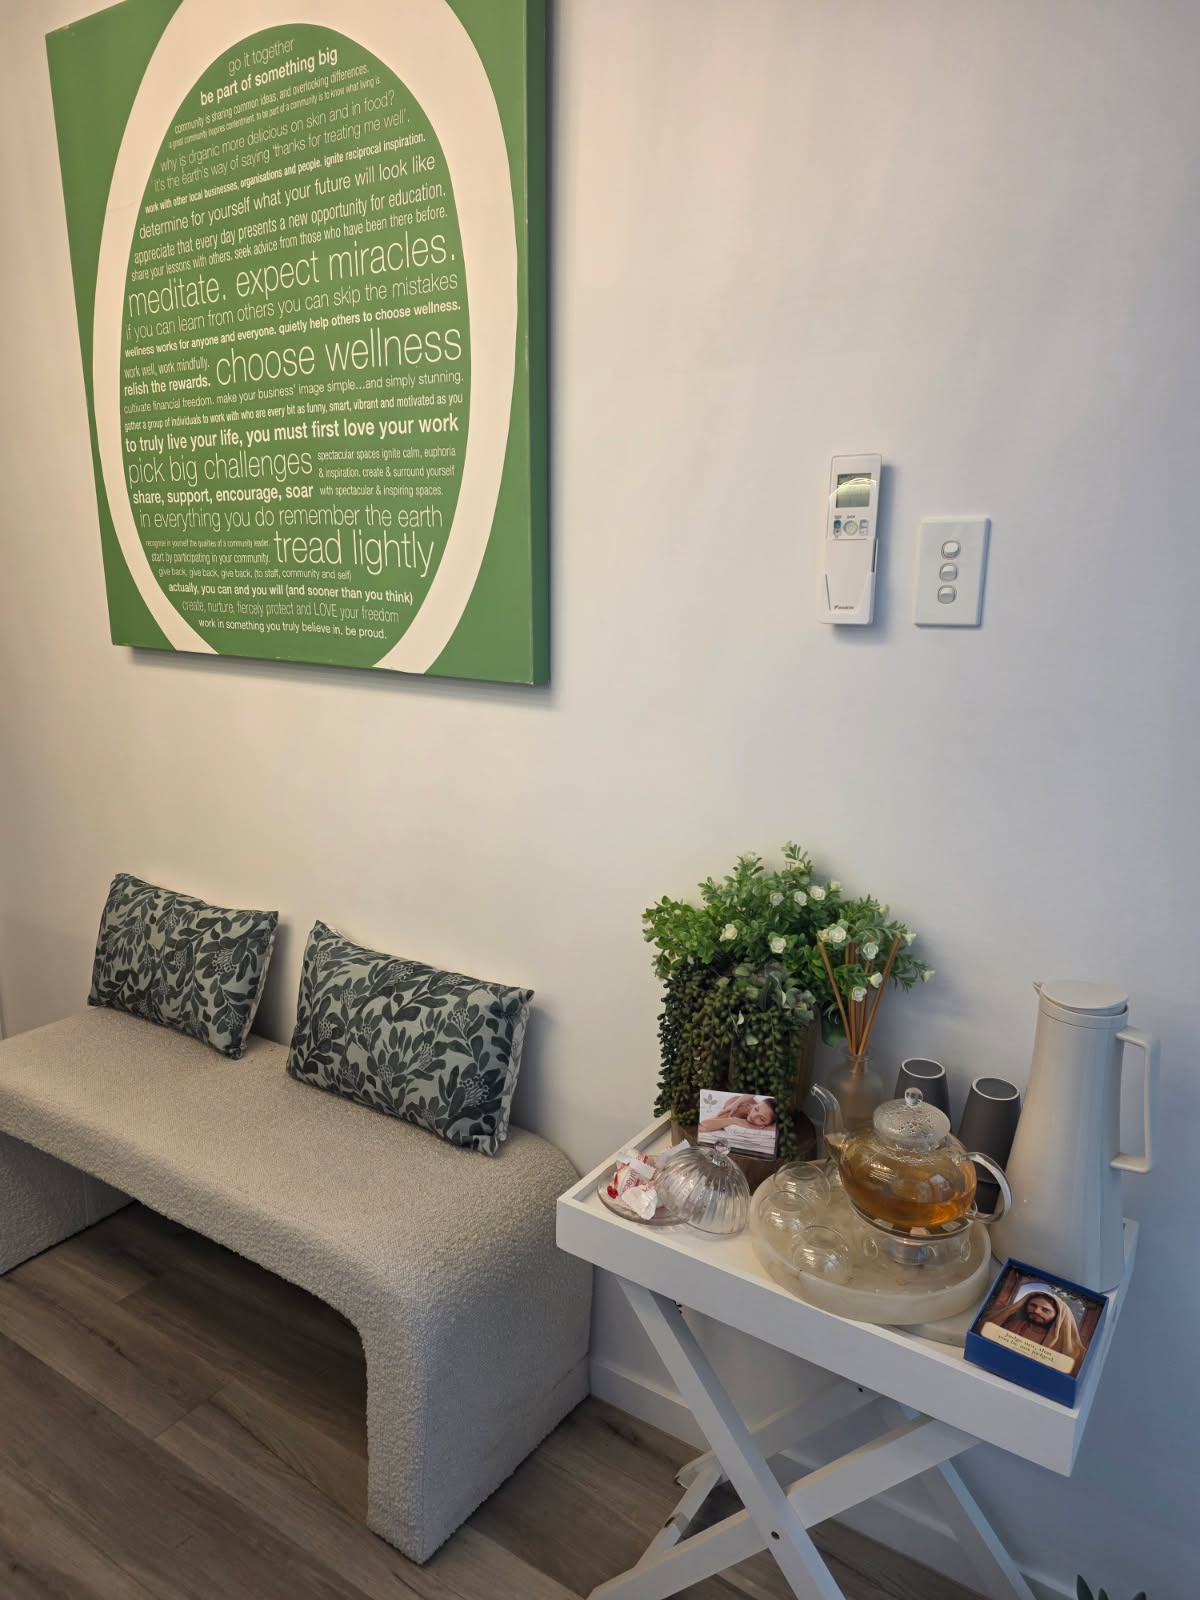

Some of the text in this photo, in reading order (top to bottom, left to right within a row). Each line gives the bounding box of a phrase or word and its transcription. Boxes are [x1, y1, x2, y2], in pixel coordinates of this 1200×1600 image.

[200, 47, 338, 106] be part of something big
[228, 39, 294, 77] go it together
[139, 154, 435, 239] determine for yourself what your future will look like
[145, 201, 159, 213] work
[159, 198, 172, 210] with
[172, 195, 188, 207] other
[188, 189, 203, 202] local
[240, 168, 283, 189] organisations
[283, 163, 296, 176] and
[323, 152, 344, 168] ignite
[345, 141, 382, 160] reciprocal
[131, 268, 149, 281] share
[149, 265, 164, 280] your
[165, 260, 191, 274] lessons
[192, 254, 207, 268] with
[234, 243, 252, 260] seek
[253, 239, 278, 255] advice
[279, 235, 298, 248] from
[299, 231, 322, 245] those
[323, 225, 341, 240] who
[343, 222, 364, 236] have
[365, 218, 387, 232] been
[389, 212, 413, 227] there
[134, 182, 445, 266] appreciate that every day presents a new opportunity for education.
[129, 230, 454, 317] meditate. expect miracles.
[125, 301, 460, 357] wellness works for anyone and everyone. quietly help others to choose wellness.
[126, 272, 457, 343] if you can learn from others you can skip the mistakes
[216, 327, 461, 385] choose wellness
[124, 373, 211, 396] relish the rewards.
[125, 412, 458, 454] to truly live your life, you must first love your work
[317, 448, 354, 461] spectacular
[356, 450, 380, 461] spaces
[381, 447, 401, 461] ignite
[424, 447, 456, 458] euphoria
[129, 450, 312, 489] pick big challenges
[319, 485, 334, 495] with
[334, 485, 374, 496] spectacular
[375, 484, 382, 495] &
[383, 485, 414, 498] inspiring
[133, 486, 313, 506] share, support, encourage, soar
[139, 503, 443, 532] in everything you do remember the earth
[273, 528, 435, 578] tread lightly
[200, 585, 216, 596] you
[217, 585, 232, 594] can
[233, 584, 250, 594] and
[251, 586, 267, 597] you
[268, 584, 283, 595] will
[285, 583, 305, 597] (and
[307, 587, 339, 598] sooner
[340, 586, 362, 599] than
[364, 590, 383, 602] you
[198, 618, 216, 628] work
[217, 618, 225, 628] in
[225, 620, 265, 633] something
[265, 622, 281, 633] you
[281, 621, 300, 634] truly
[301, 621, 331, 634] believe
[345, 625, 357, 636] be
